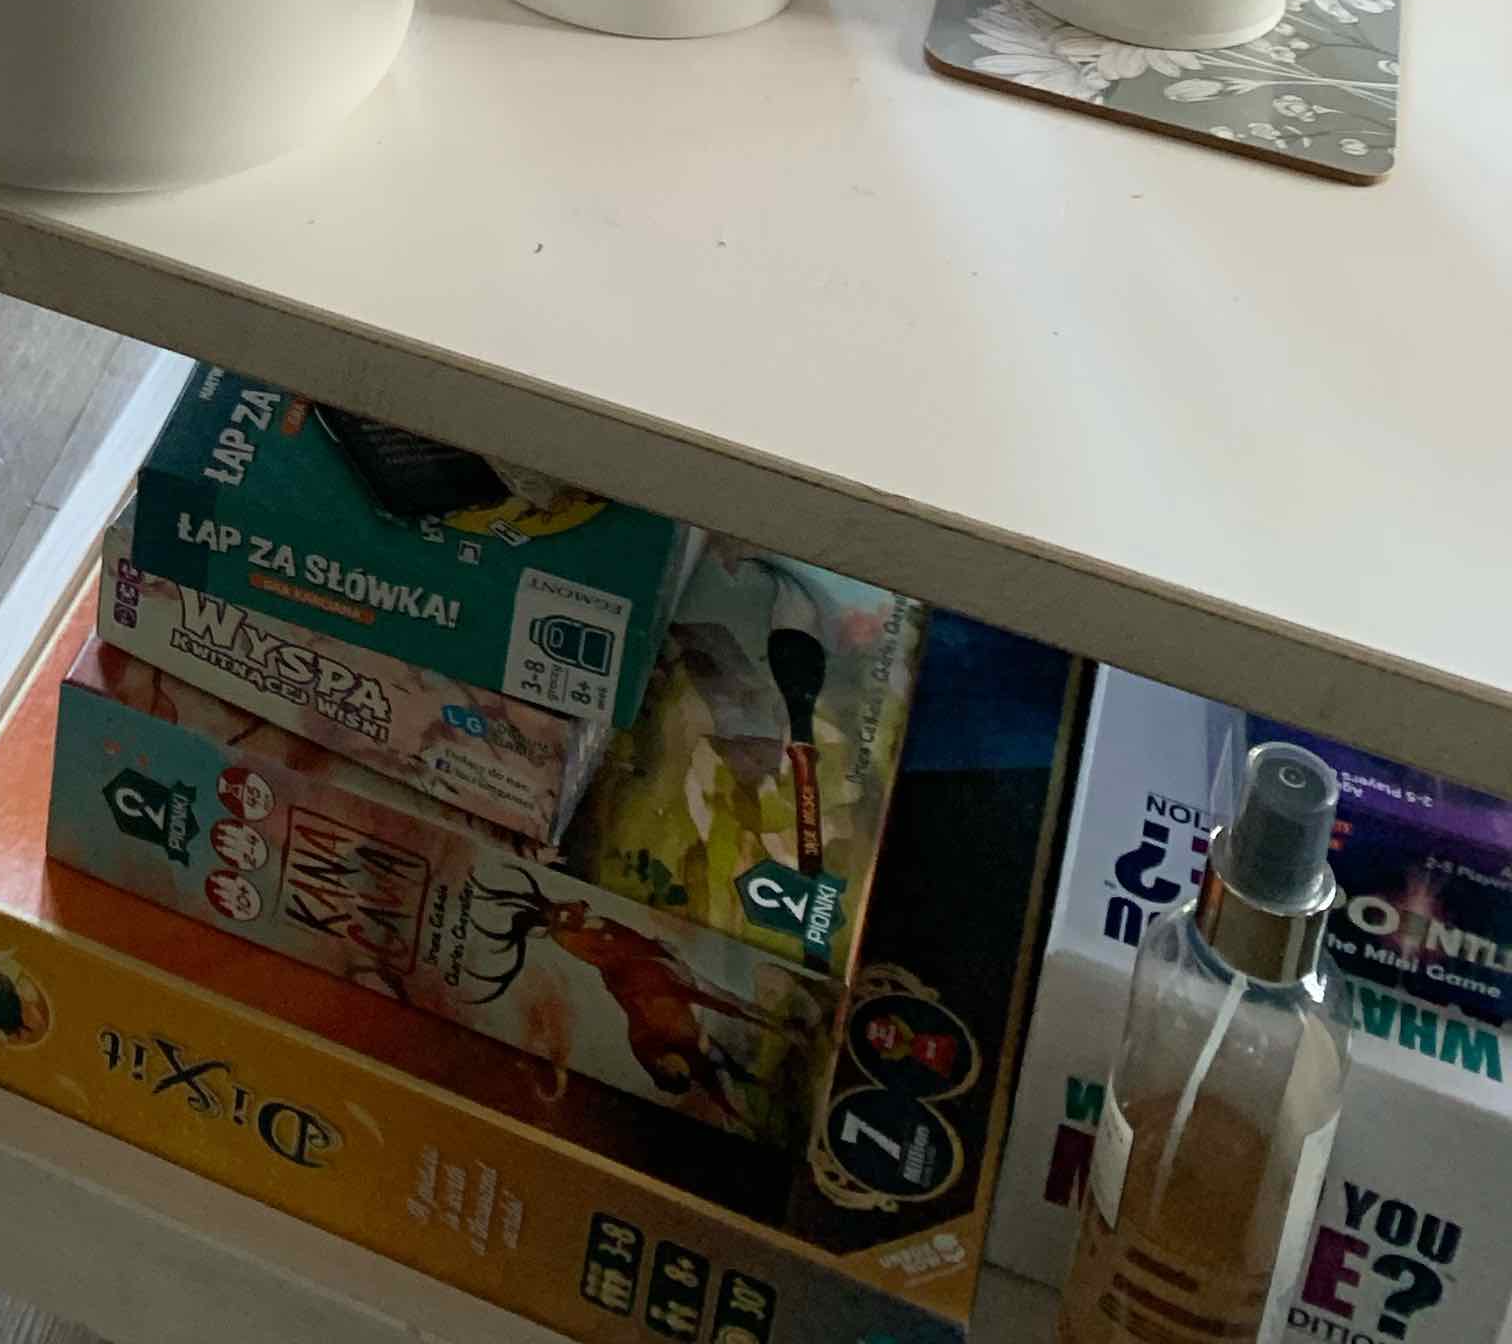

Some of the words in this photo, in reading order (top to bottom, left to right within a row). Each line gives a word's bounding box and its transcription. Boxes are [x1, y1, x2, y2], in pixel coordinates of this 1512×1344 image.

[201, 427, 257, 487] ŁAP
[231, 388, 282, 431] ZA
[176, 512, 242, 554] ŁAP
[248, 535, 297, 577] ZA
[304, 553, 462, 630] SŁÓWKA!
[530, 576, 623, 615] EGMONT
[176, 584, 392, 723] WYSPA
[521, 659, 545, 694] 3-8
[571, 680, 591, 705] 8+
[167, 793, 187, 851] PIONKI
[805, 881, 839, 948] PIONKI
[1363, 941, 1419, 976] Mini
[1425, 962, 1503, 1000] Game
[1344, 1181, 1461, 1264] YOU
